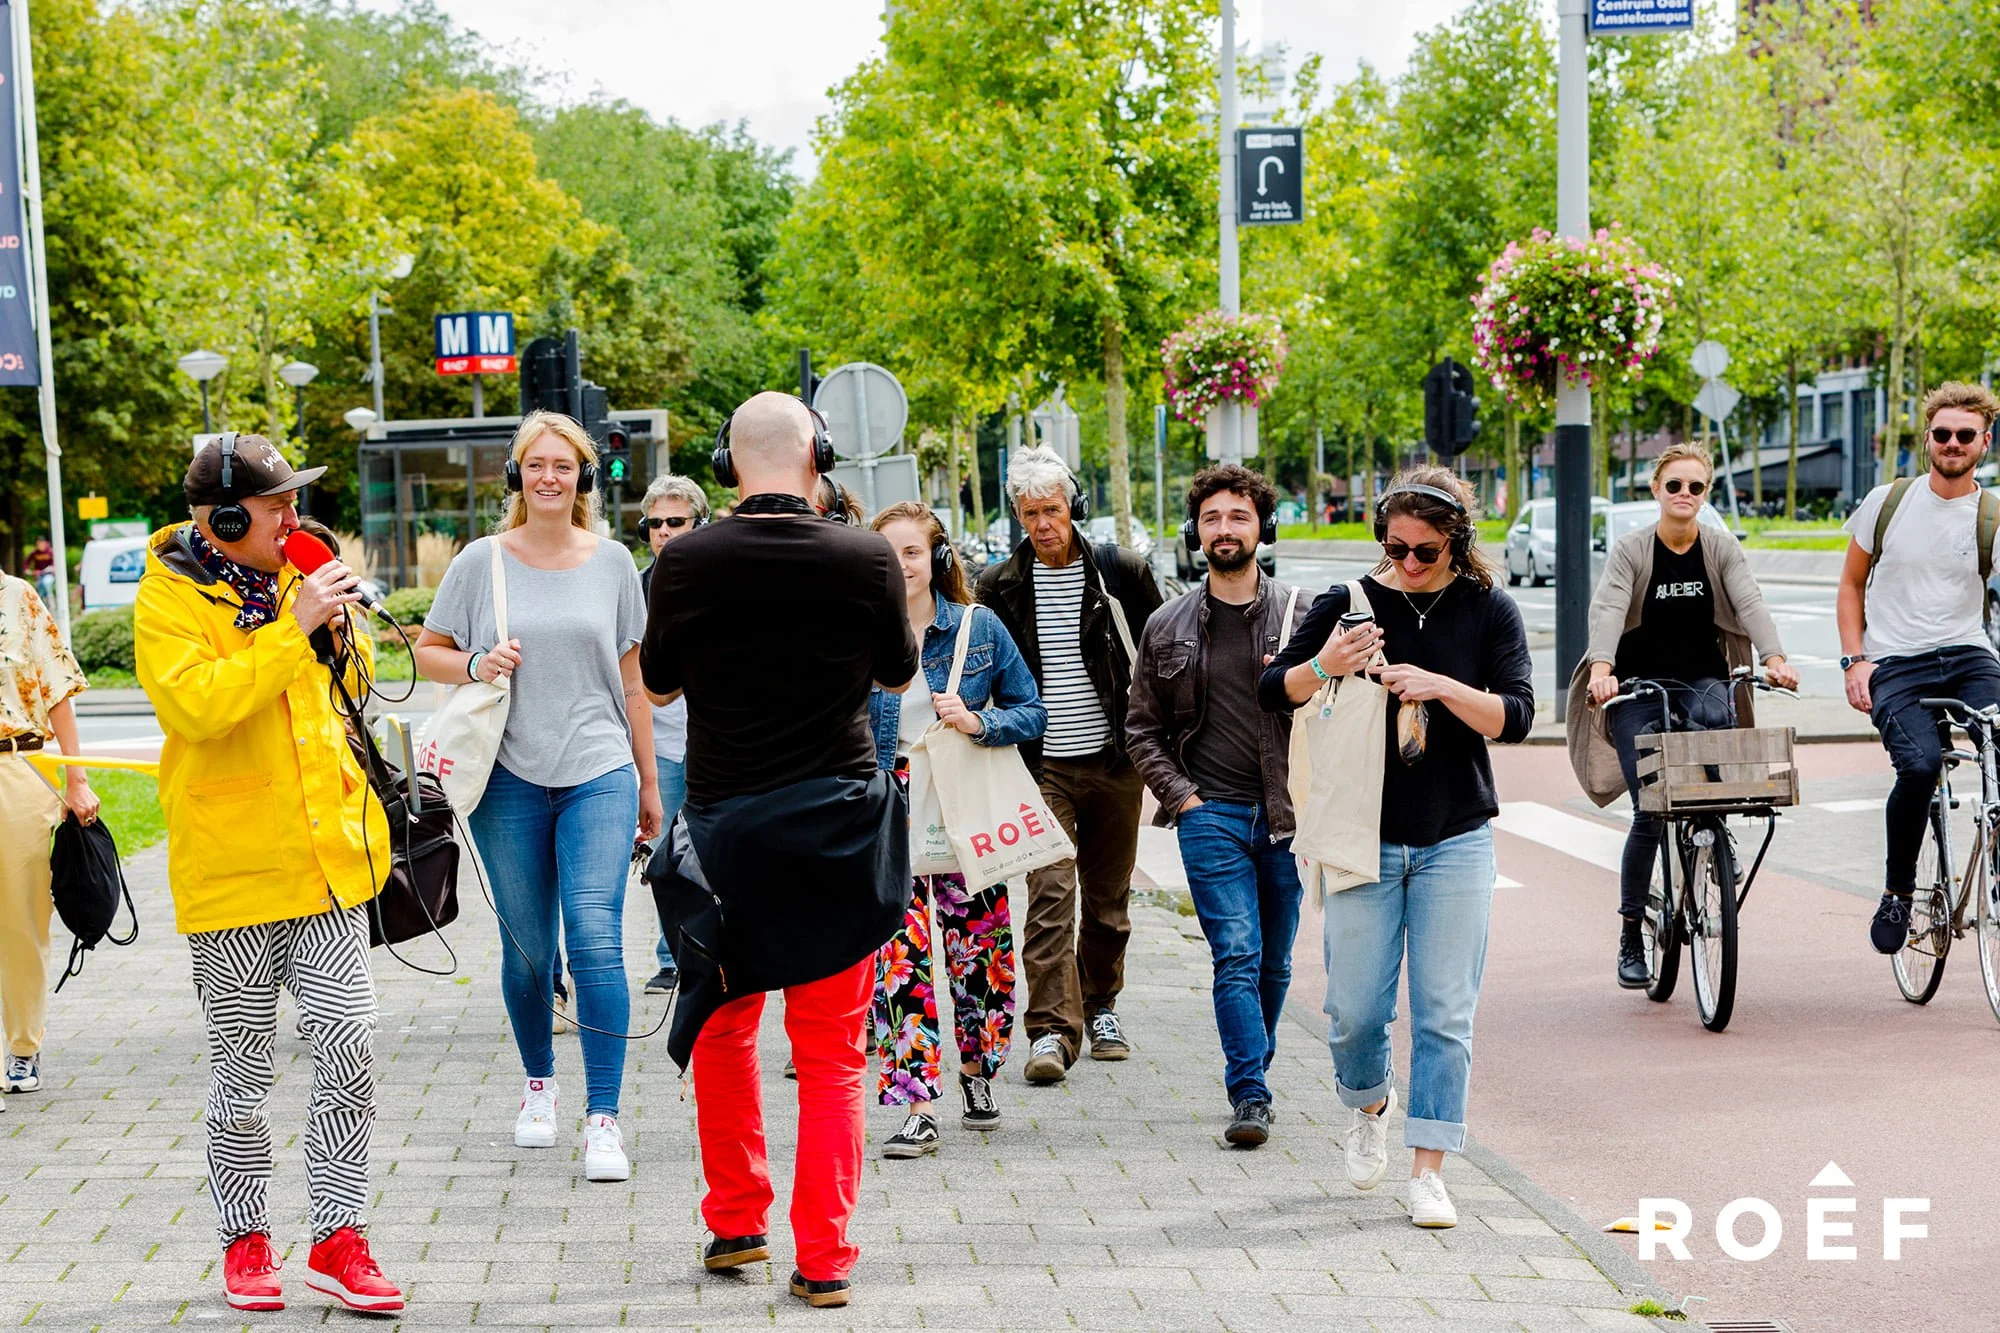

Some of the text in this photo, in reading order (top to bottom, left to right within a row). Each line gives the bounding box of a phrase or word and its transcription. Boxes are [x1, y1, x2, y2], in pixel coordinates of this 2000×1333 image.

[1596, 0, 1655, 11] Centrum
[1595, 11, 1690, 26] Amstelcampus
[441, 315, 509, 356] M M
